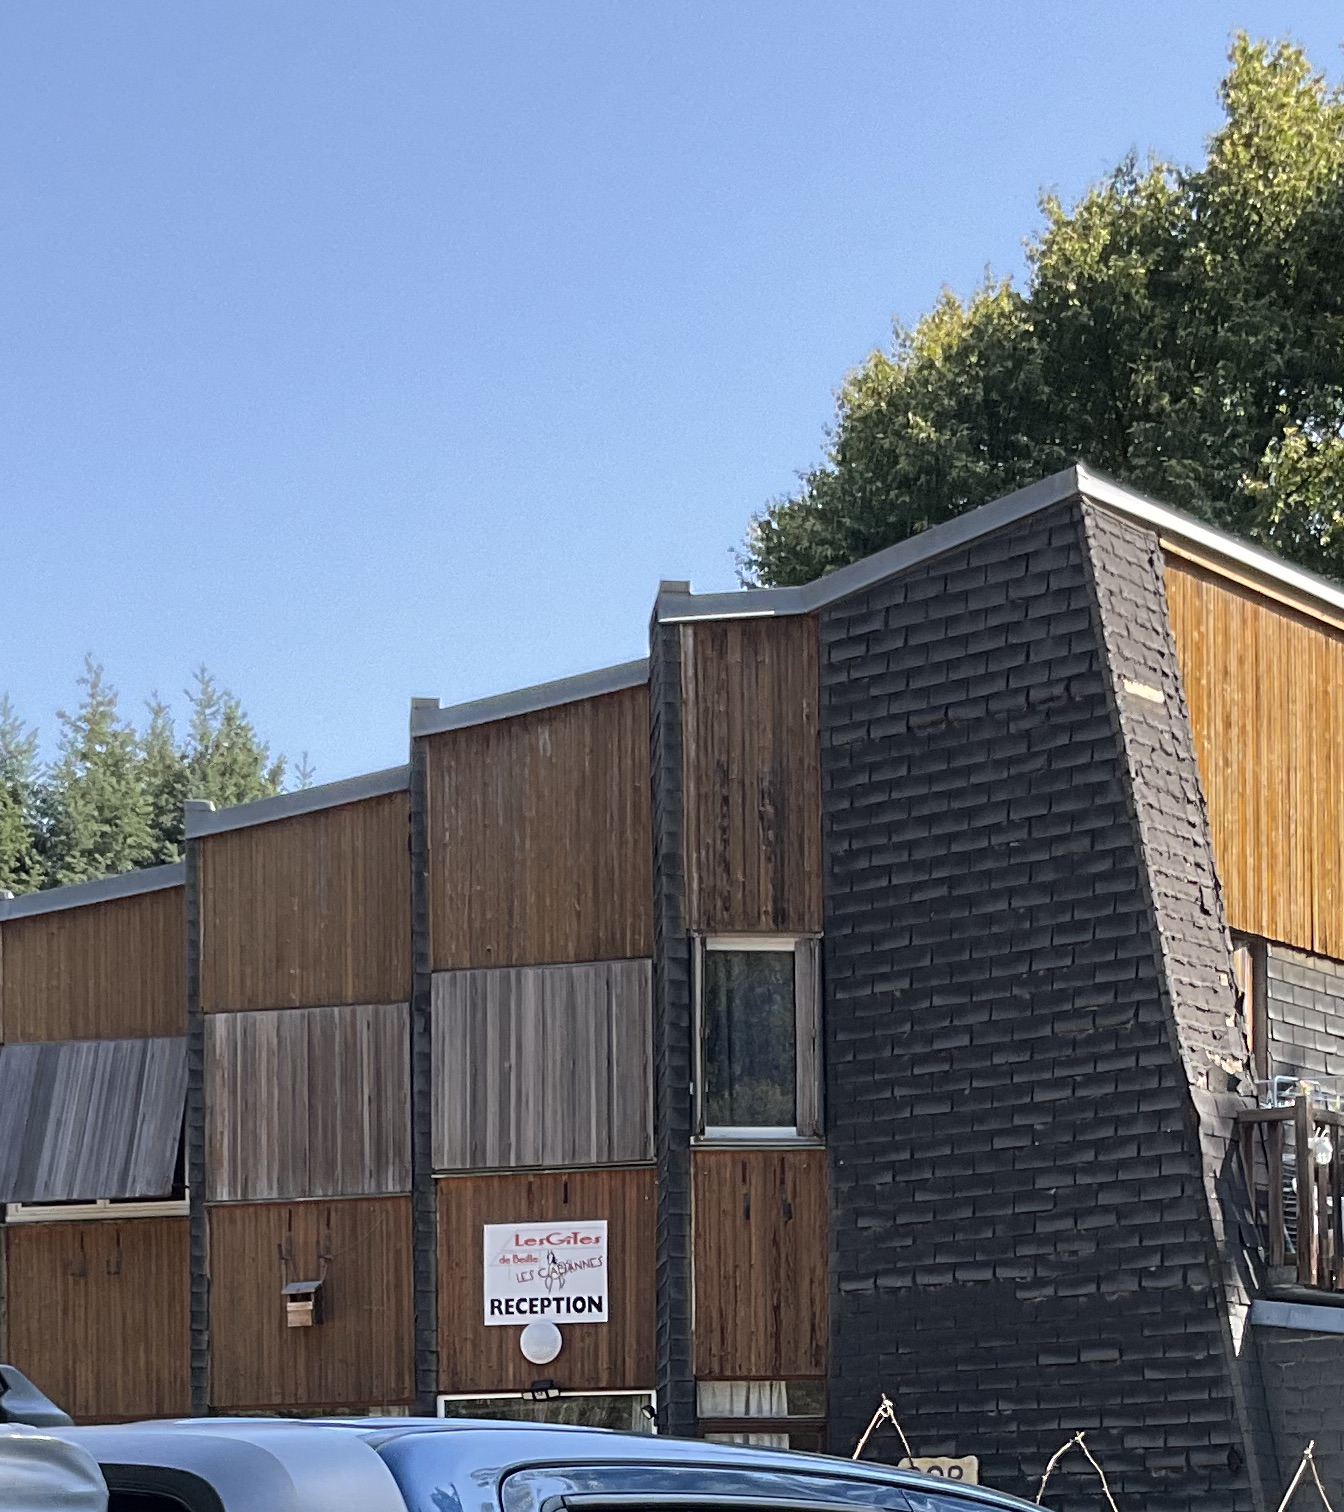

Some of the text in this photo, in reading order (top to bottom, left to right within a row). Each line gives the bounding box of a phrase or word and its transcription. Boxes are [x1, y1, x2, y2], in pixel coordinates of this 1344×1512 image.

[499, 1255, 511, 1264] de
[516, 1269, 535, 1283] LES
[490, 1296, 603, 1315] RECEPTION
